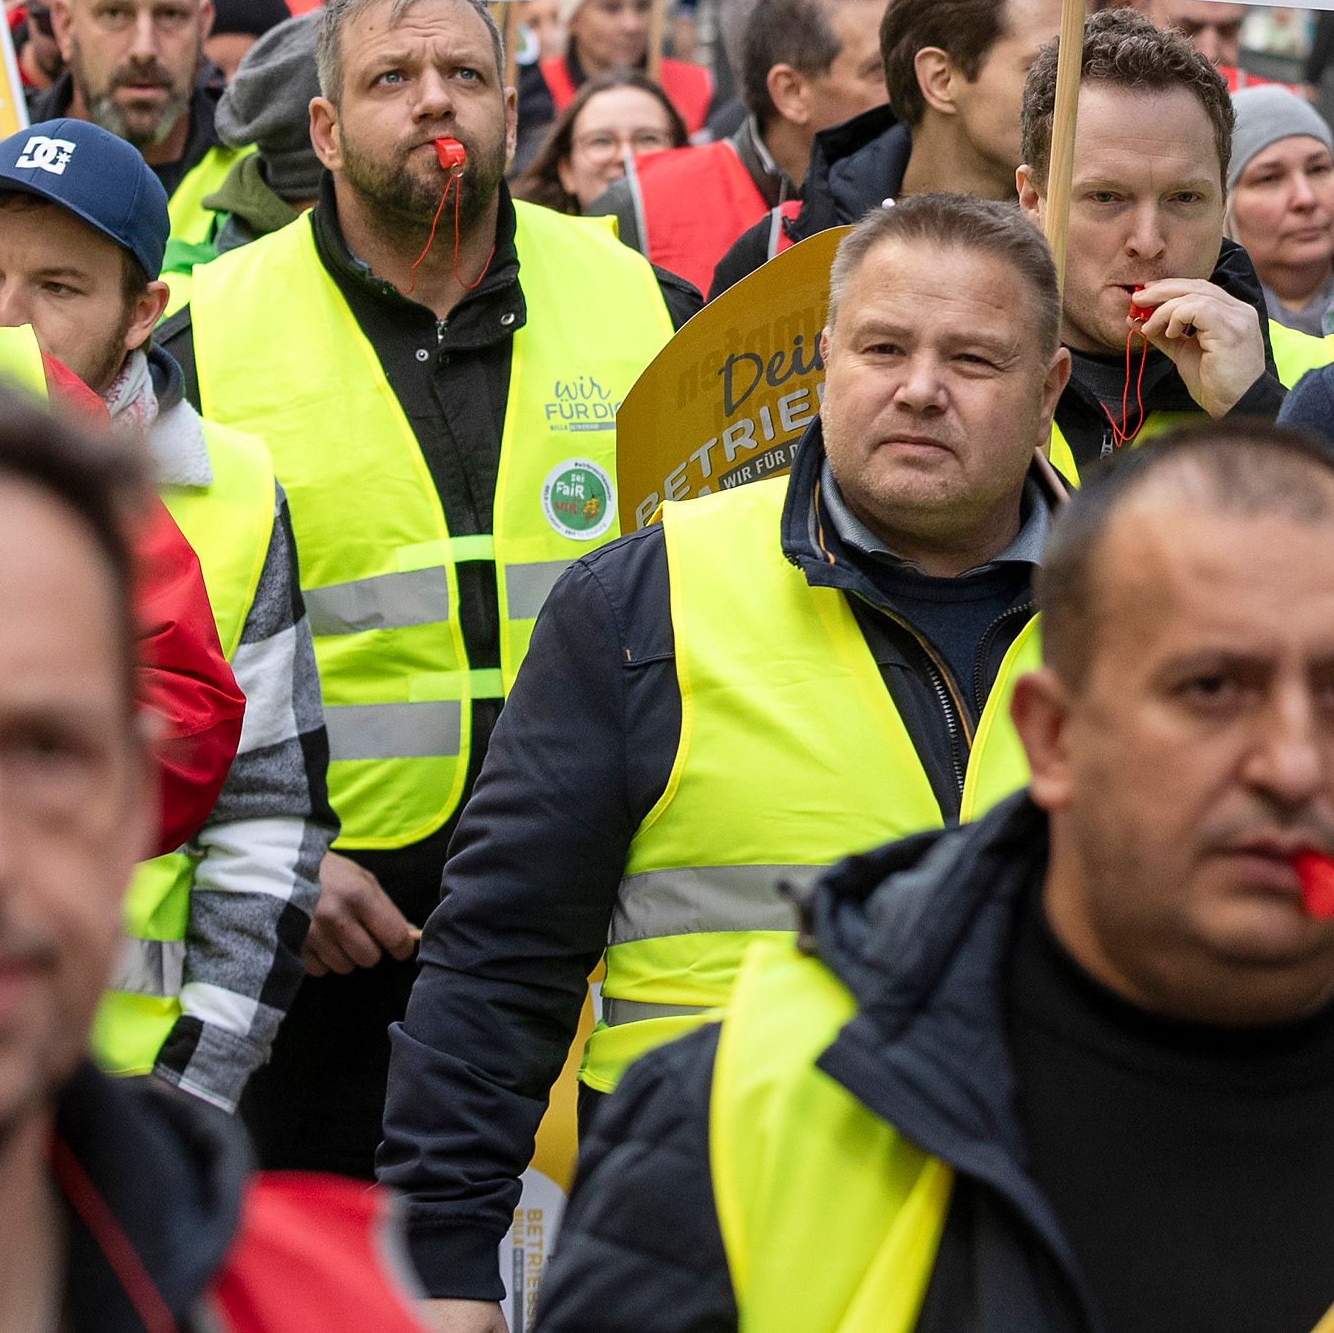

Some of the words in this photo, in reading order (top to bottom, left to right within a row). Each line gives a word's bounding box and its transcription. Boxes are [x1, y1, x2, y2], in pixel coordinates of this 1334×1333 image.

[544, 398, 590, 421] FÜR
[723, 466, 753, 490] WIR
[756, 447, 786, 475] FÜR
